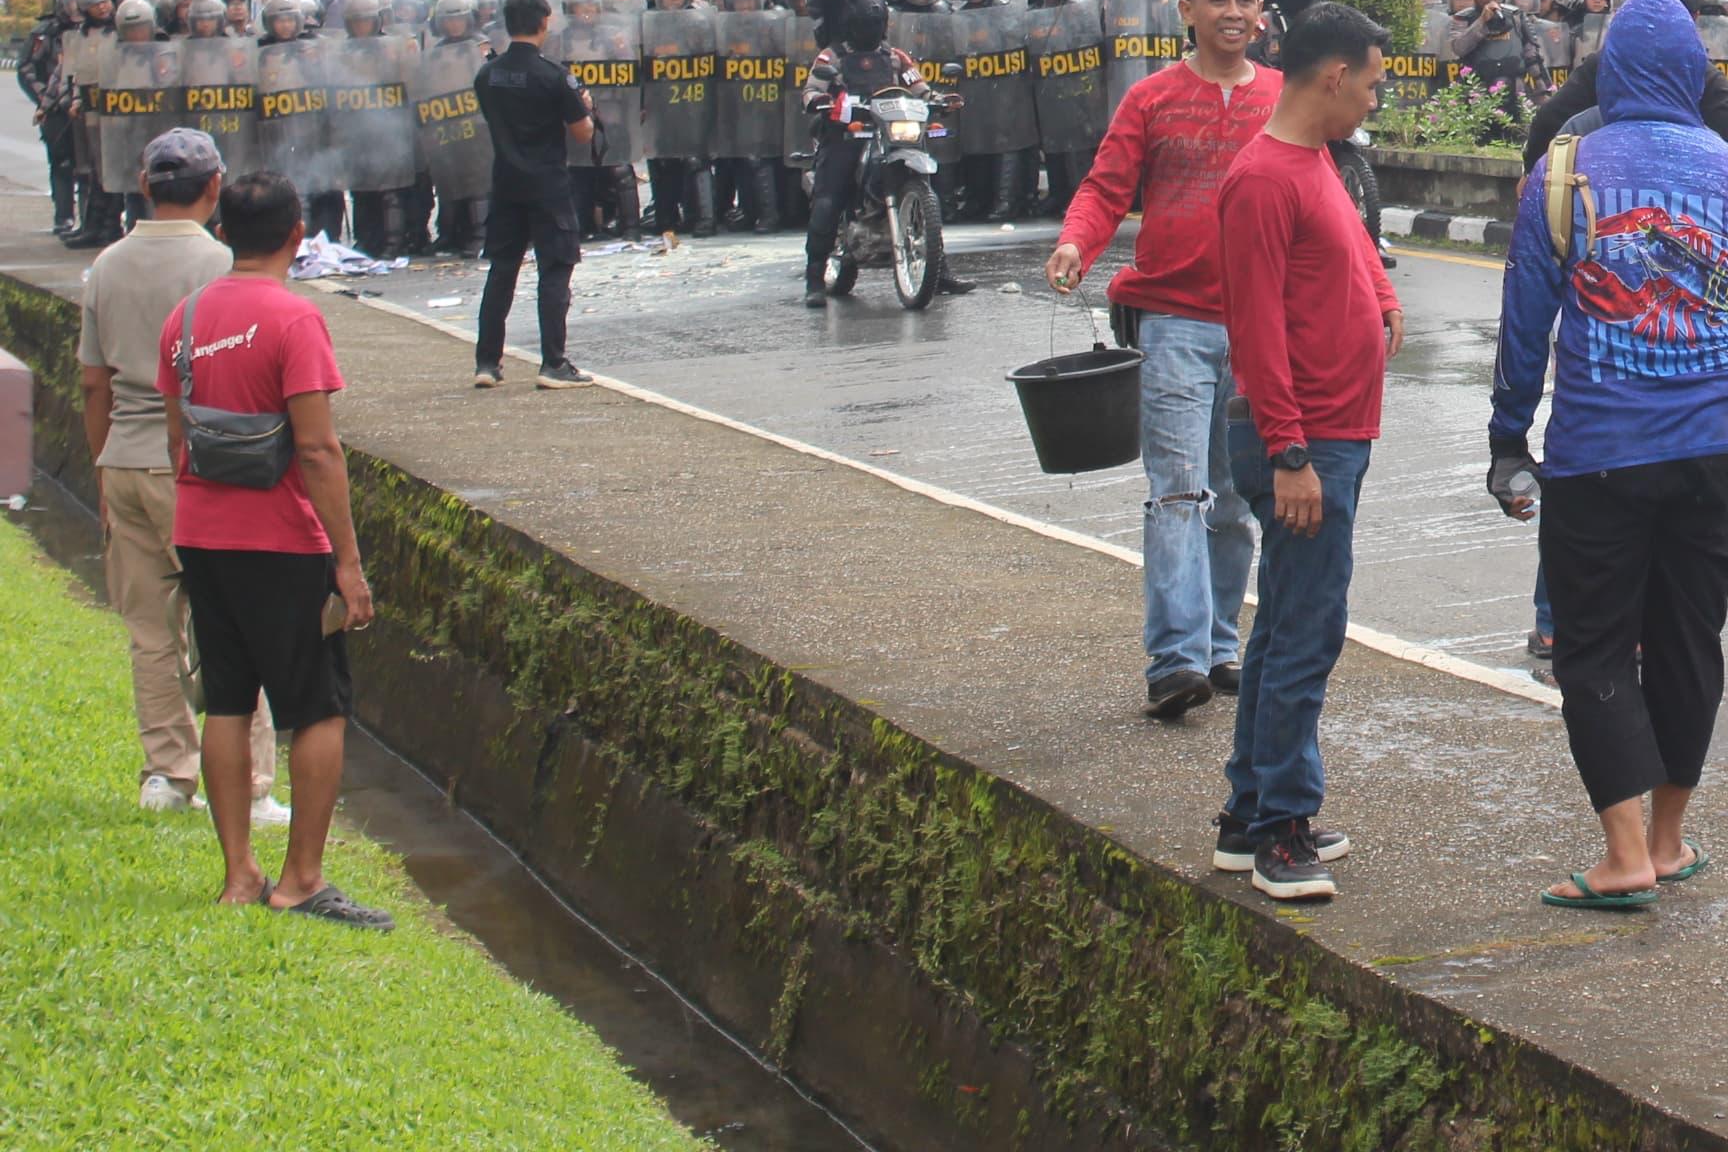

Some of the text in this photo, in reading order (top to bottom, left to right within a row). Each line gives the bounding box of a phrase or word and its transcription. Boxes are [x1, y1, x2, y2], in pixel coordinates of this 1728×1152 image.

[1115, 37, 1177, 58] POLISI
[653, 55, 714, 80] POLISI
[726, 58, 789, 80] POLIS
[965, 50, 1025, 78] POLISI
[1039, 47, 1100, 77] POLISI
[1381, 56, 1437, 78] POLISI
[570, 63, 633, 85] POLISI
[187, 87, 253, 111] POLISI
[263, 88, 328, 117] POLISI
[336, 86, 402, 110] POLISI
[668, 83, 706, 104] 24B
[742, 83, 779, 103] 04B
